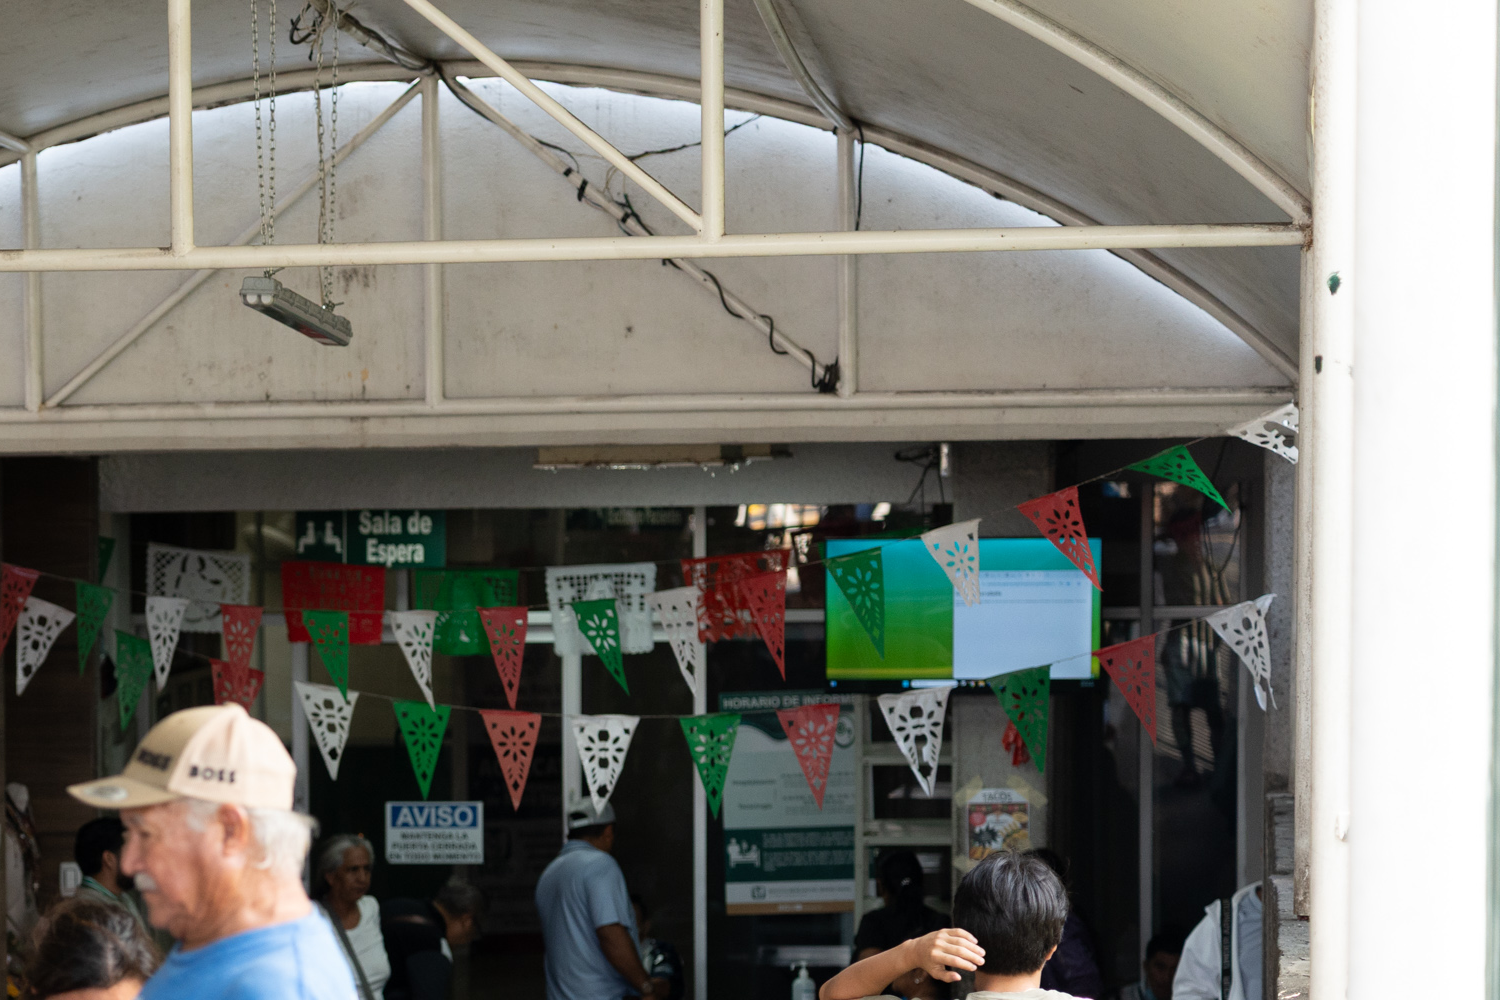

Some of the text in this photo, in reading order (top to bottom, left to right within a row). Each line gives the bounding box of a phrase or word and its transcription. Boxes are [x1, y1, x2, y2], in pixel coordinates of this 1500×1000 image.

[358, 511, 433, 535] Sala de
[365, 537, 426, 568] Espera
[723, 696, 780, 710] HORARIO
[782, 695, 799, 708] DE
[982, 791, 1013, 803] TACOS
[395, 806, 474, 827] AVISO
